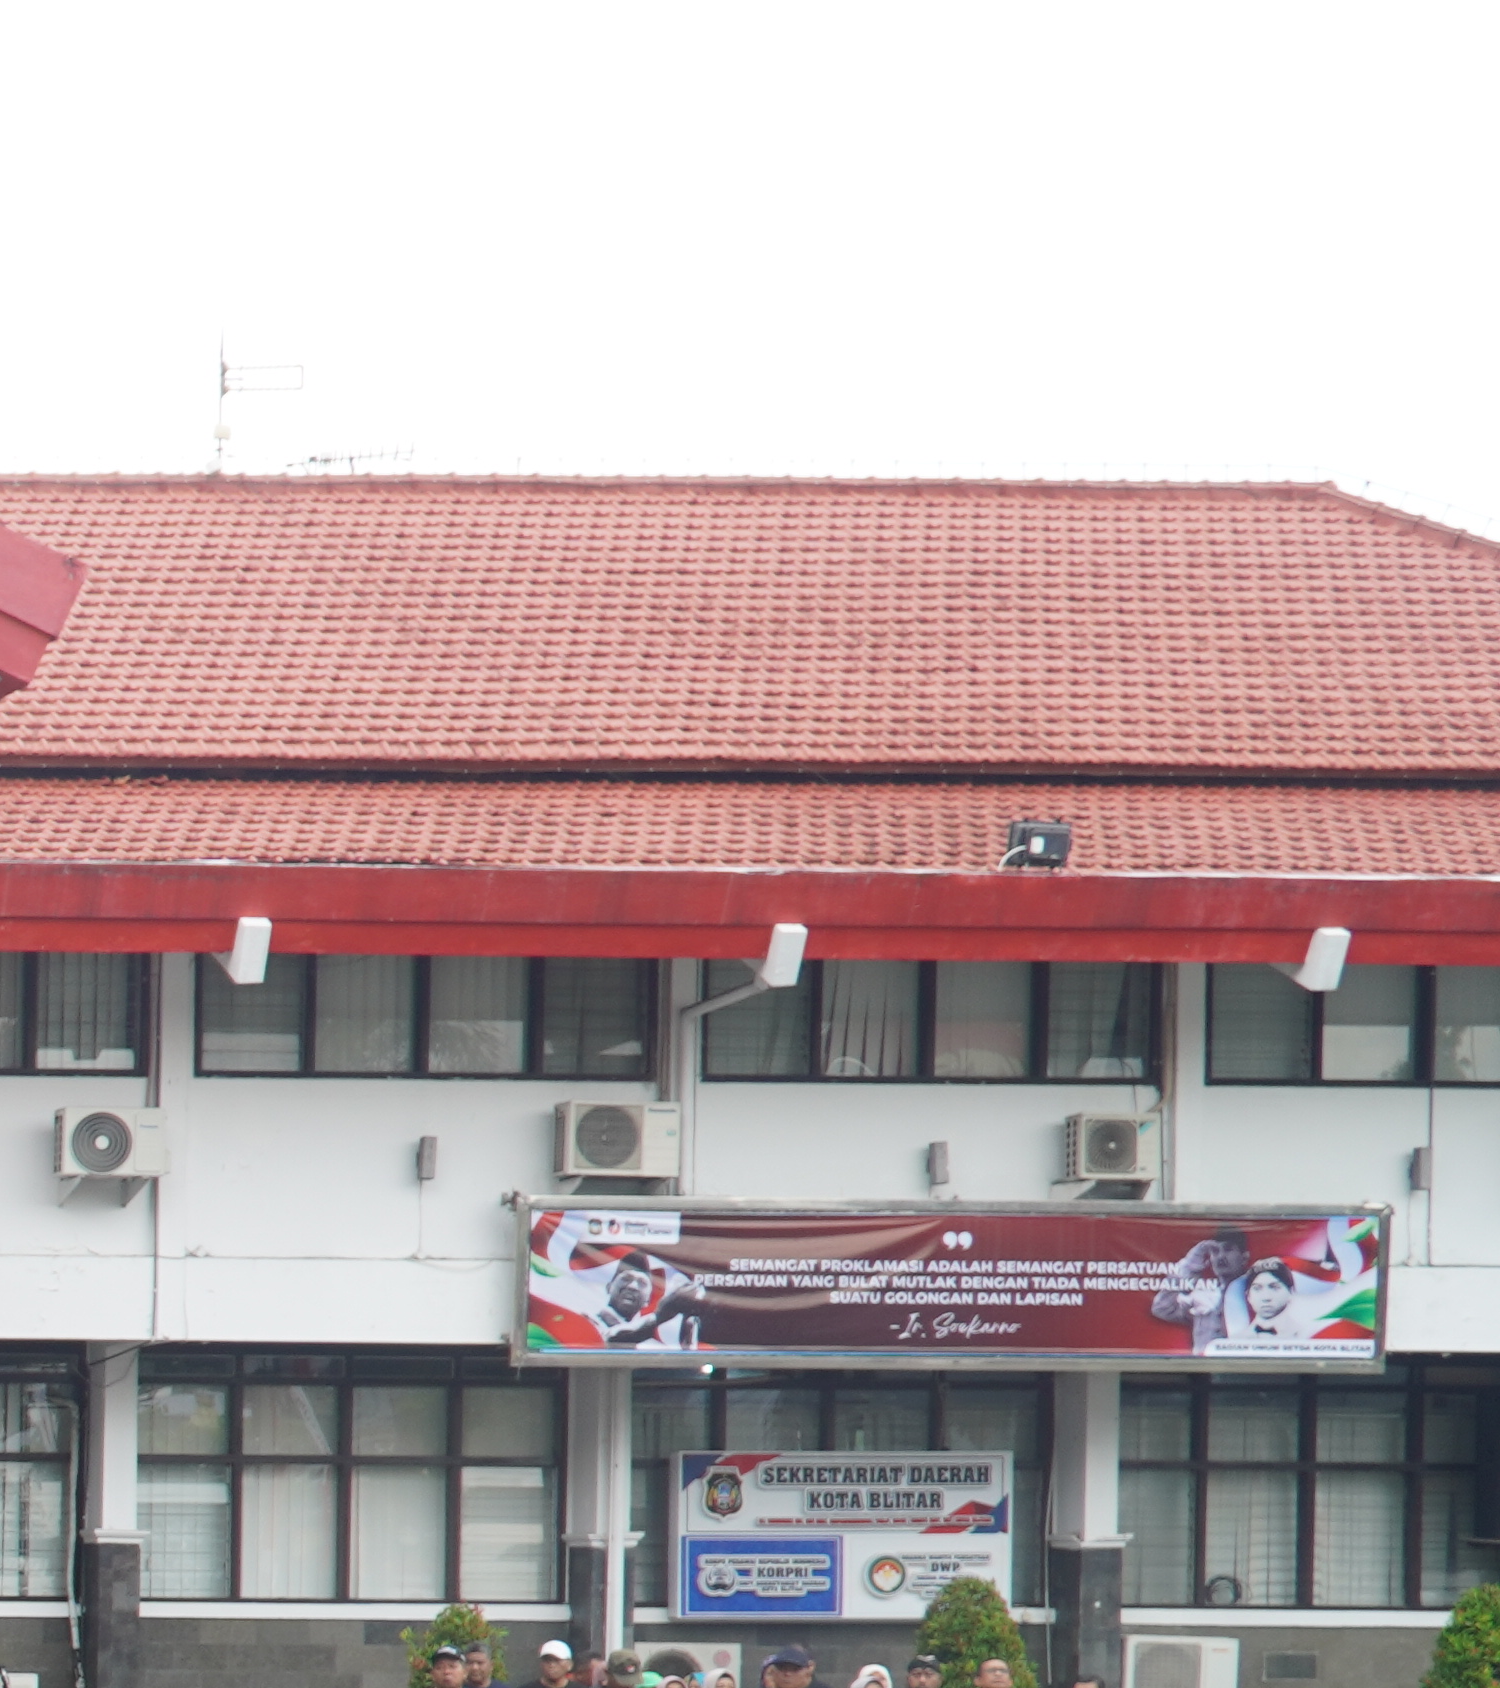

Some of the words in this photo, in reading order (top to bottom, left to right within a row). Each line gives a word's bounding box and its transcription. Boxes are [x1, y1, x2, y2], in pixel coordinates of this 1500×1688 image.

[729, 1258, 817, 1272] SEMANGAT
[821, 1259, 924, 1273] PROKLAMASI
[927, 1260, 993, 1273] ADALAH
[996, 1260, 1084, 1274] SEMANGAT
[1086, 1261, 1180, 1275] PERSATUAN
[693, 1274, 787, 1288] PERSATUAN
[791, 1275, 835, 1288] YANG
[838, 1275, 888, 1288] BULAT
[891, 1275, 957, 1289] MUTLAK
[960, 1276, 1028, 1289] DENGAN
[1031, 1276, 1080, 1290] TIADA
[1083, 1277, 1219, 1291] MENGECUALIKAN
[829, 1291, 881, 1304] SUATU
[884, 1292, 974, 1305] GOLONGAN
[977, 1292, 1013, 1306] DAN
[1015, 1293, 1084, 1306] LAPISAN
[762, 1465, 903, 1483] SEKRETARIAT
[910, 1465, 990, 1483] DAERAH
[808, 1491, 862, 1509] KOTA
[868, 1491, 942, 1509] BLITAR
[757, 1567, 808, 1578] KORPRI
[931, 1562, 960, 1572] DWP
